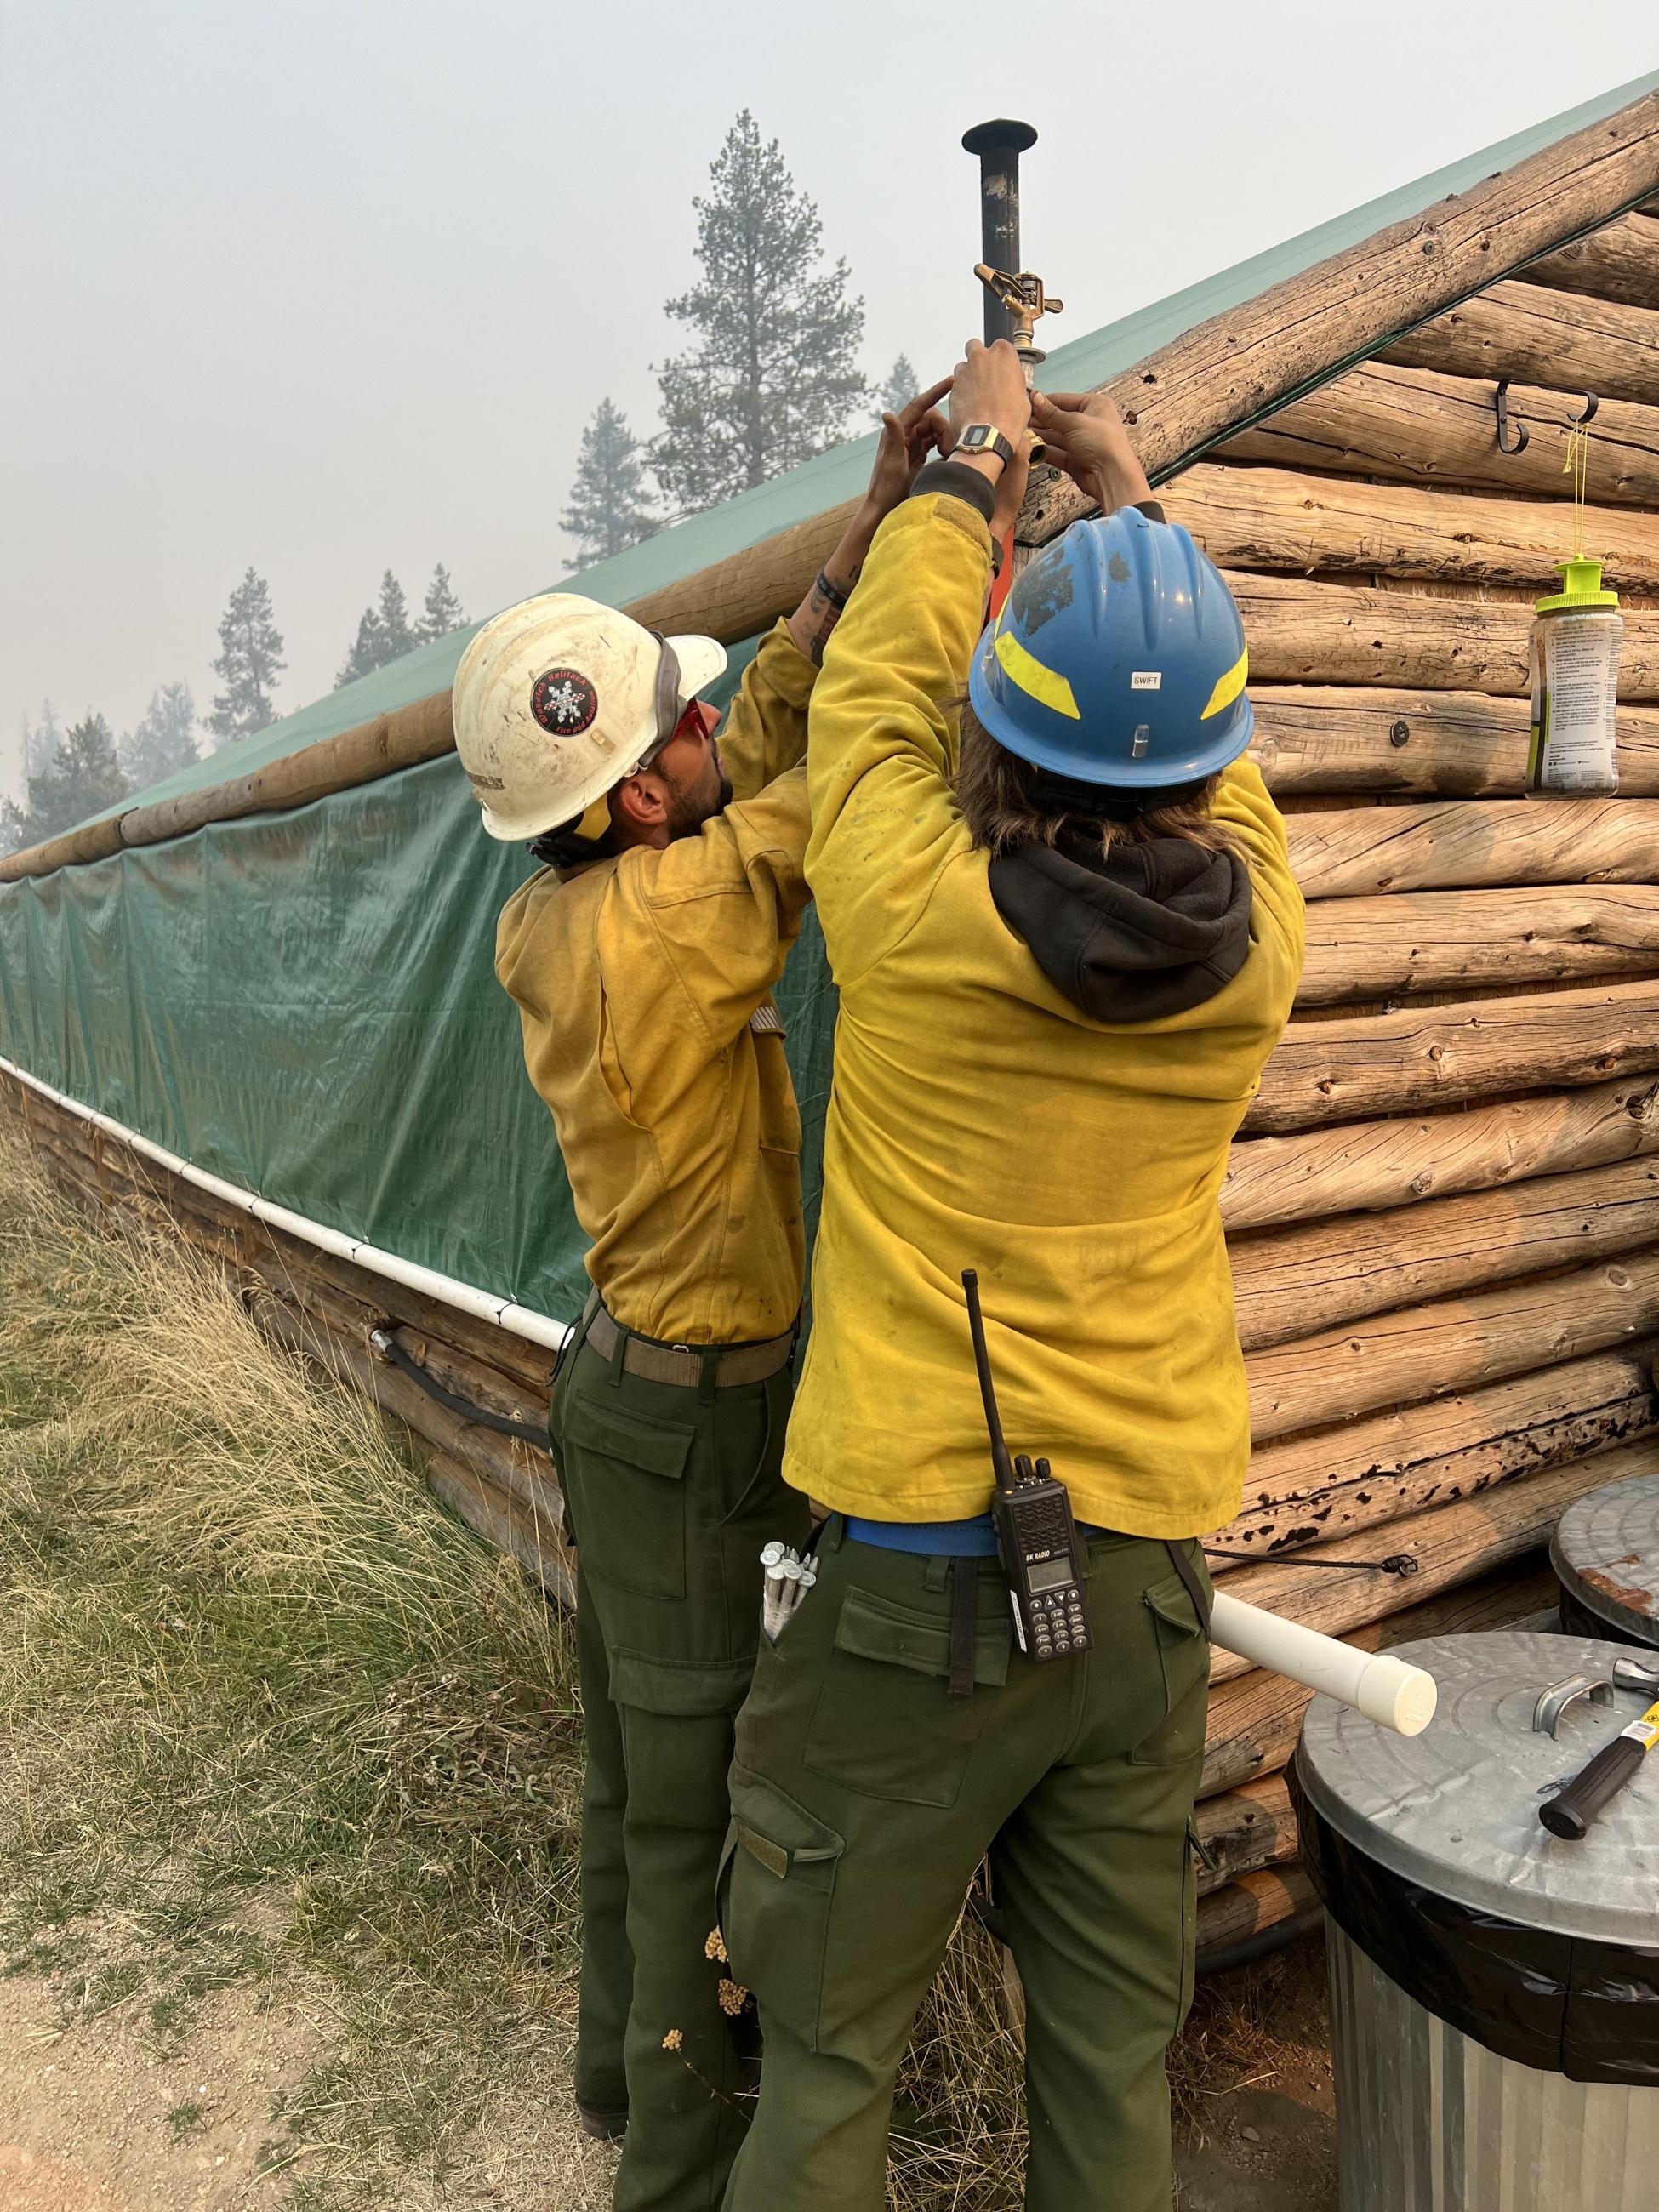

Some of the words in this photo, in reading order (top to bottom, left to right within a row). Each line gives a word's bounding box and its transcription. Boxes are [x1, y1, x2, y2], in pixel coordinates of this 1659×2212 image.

[535, 681, 547, 722] Wasatch
[548, 670, 586, 687] Helitack
[1035, 1550, 1050, 1559] RADIO
